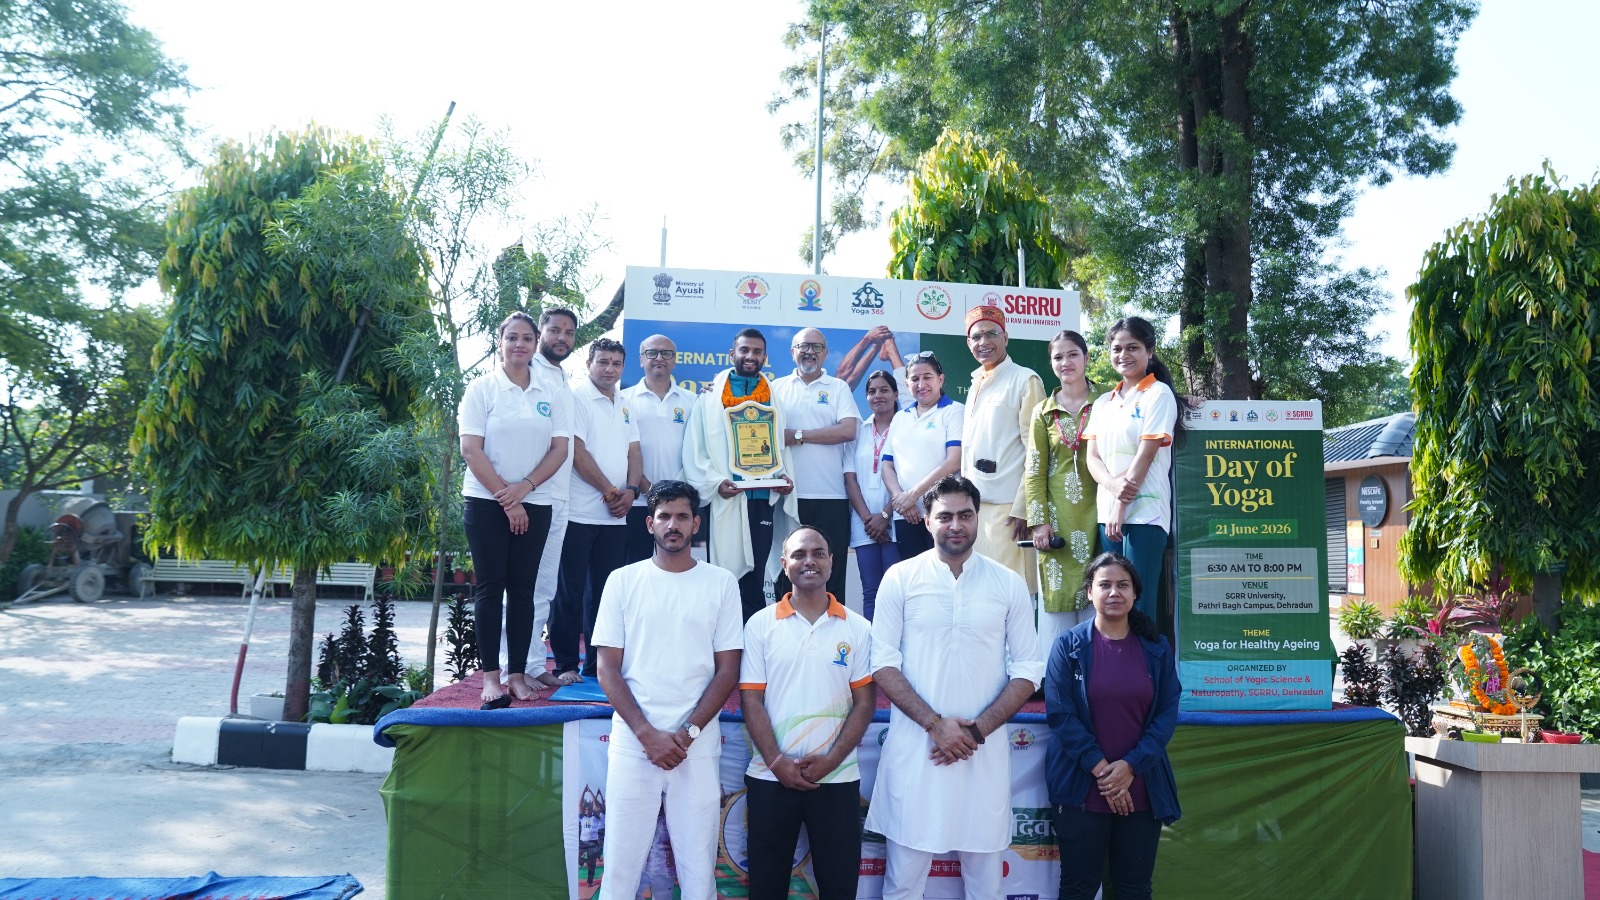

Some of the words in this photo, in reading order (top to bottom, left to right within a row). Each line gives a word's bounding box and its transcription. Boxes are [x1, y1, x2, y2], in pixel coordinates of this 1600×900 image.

[675, 286, 705, 295] Ayush
[1004, 294, 1061, 317] SGRRU
[1033, 318, 1061, 327] UNIVERSITY
[1205, 439, 1295, 450] INTERNATIONAL
[1204, 454, 1260, 485] Day
[1266, 452, 1298, 478] of
[1205, 482, 1275, 513] Yoga
[1215, 524, 1228, 535] 21
[1229, 523, 1258, 537] June
[1261, 523, 1292, 534] 2026
[1245, 552, 1264, 560] TIME
[1207, 564, 1228, 573] 6:30
[1230, 564, 1246, 573] AM
[1248, 564, 1261, 572] TO
[1263, 563, 1285, 573] 8:00
[1287, 563, 1302, 572] PM
[1242, 581, 1269, 589] VENUE
[1225, 592, 1246, 600] SGRR
[1247, 592, 1286, 601] University,
[1198, 602, 1220, 610] Pathri
[1222, 602, 1242, 612] Bagh
[1243, 602, 1275, 611] Campus,
[1276, 601, 1313, 609] Dehradun
[1243, 629, 1270, 637] THEME
[1194, 640, 1220, 652] Yoga
[1222, 639, 1237, 649] for
[1240, 639, 1280, 651] Healthy
[1282, 639, 1320, 651] Ageing
[1227, 664, 1275, 672] ORGANIZED
[1276, 664, 1287, 672] BY
[1204, 676, 1233, 684] School
[1234, 675, 1244, 683] of
[1245, 675, 1268, 685] Yogic
[1269, 675, 1303, 683] Science
[1304, 675, 1311, 683] &
[1191, 688, 1247, 698] Naturopathy,
[1248, 688, 1280, 697] SGRRU,
[1282, 687, 1324, 696] Dehradun
[1038, 849, 1047, 857] 21
